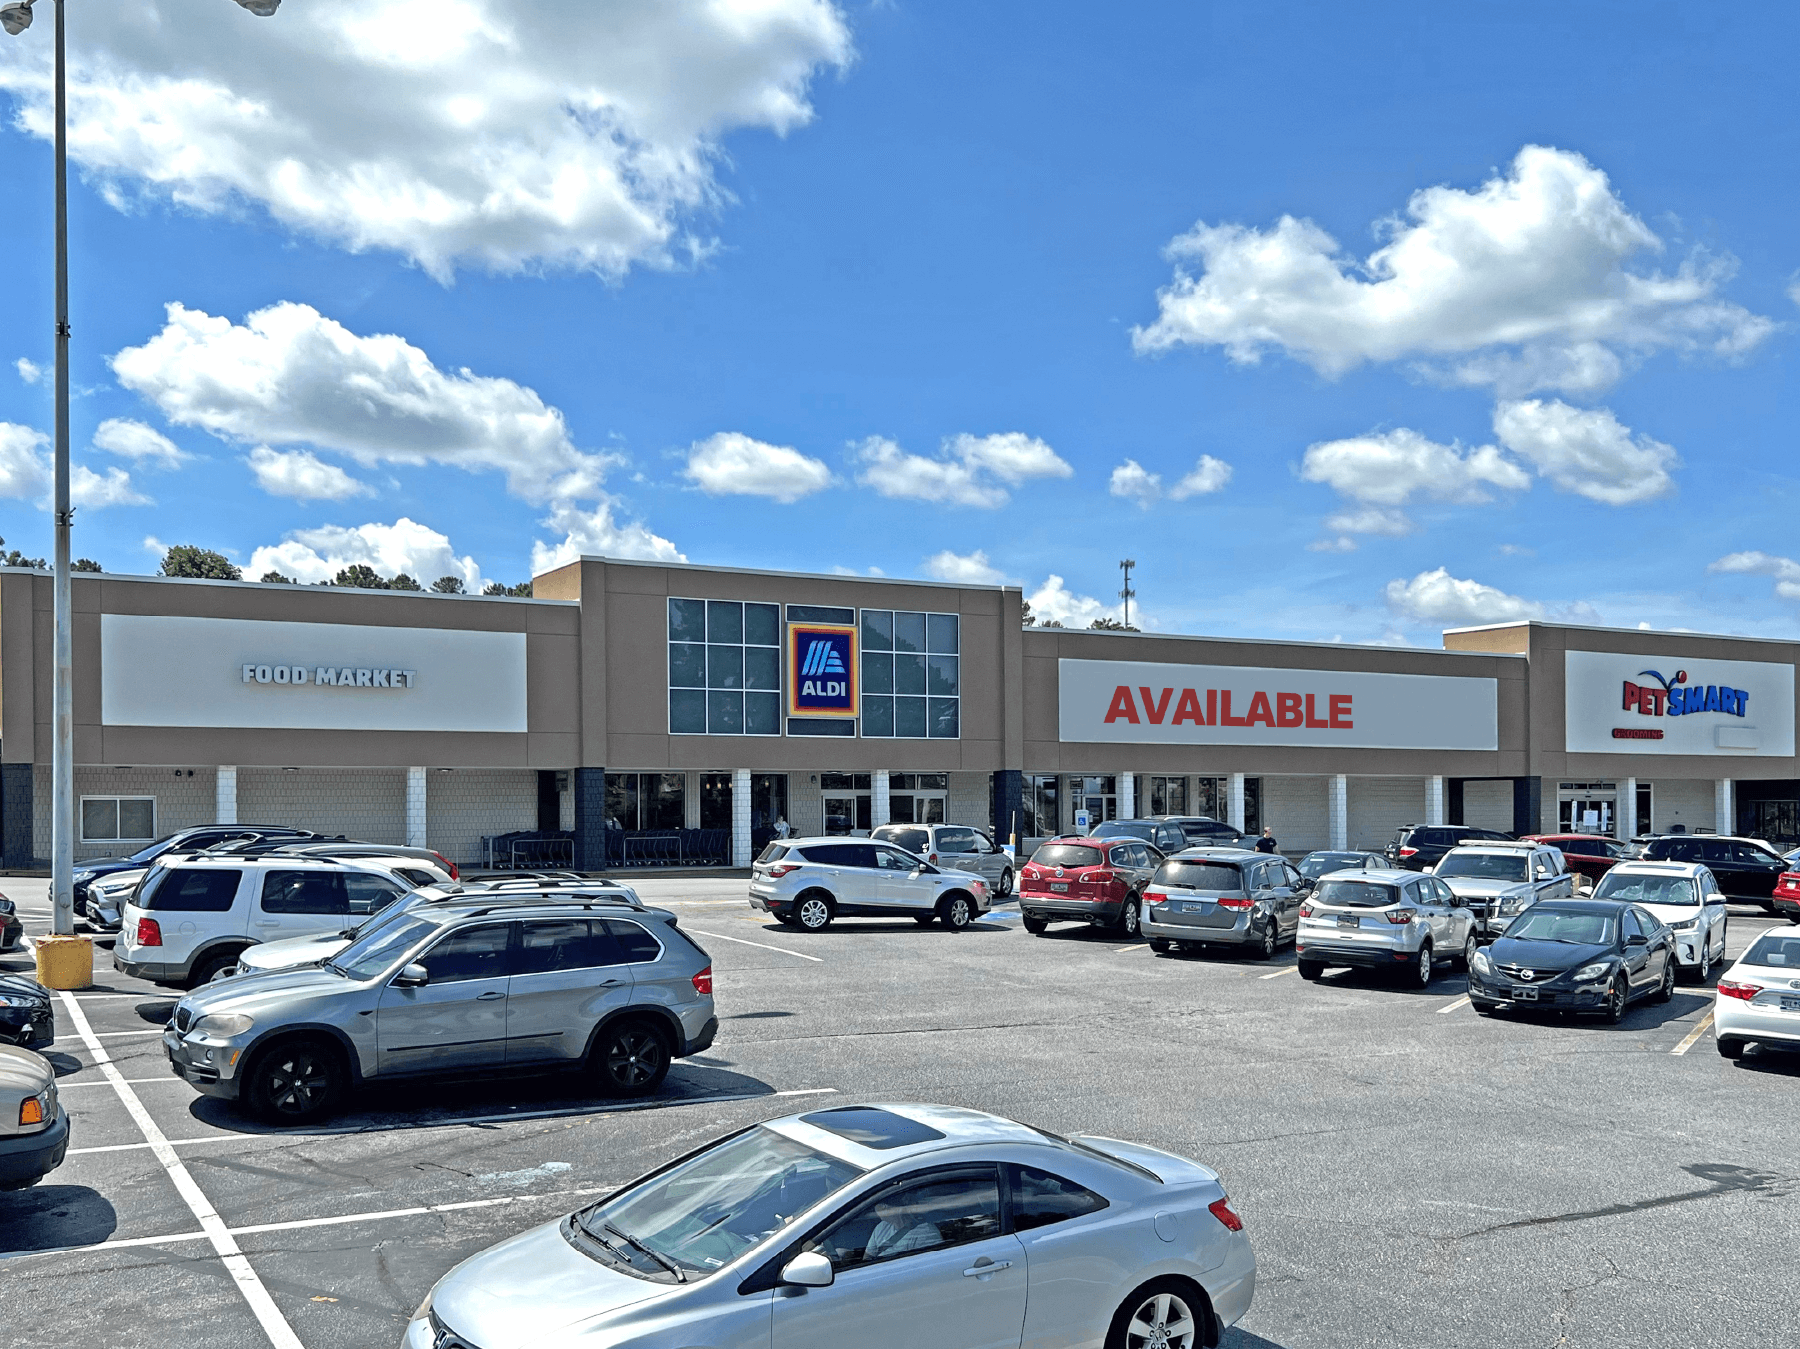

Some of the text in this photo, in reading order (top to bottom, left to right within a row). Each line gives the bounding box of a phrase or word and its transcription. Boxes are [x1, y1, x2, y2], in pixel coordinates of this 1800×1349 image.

[242, 664, 417, 688] FOOD MARKET
[801, 681, 846, 696] ALDI
[1103, 685, 1354, 729] AVAILABLE
[1612, 728, 1664, 739] GROOMING
